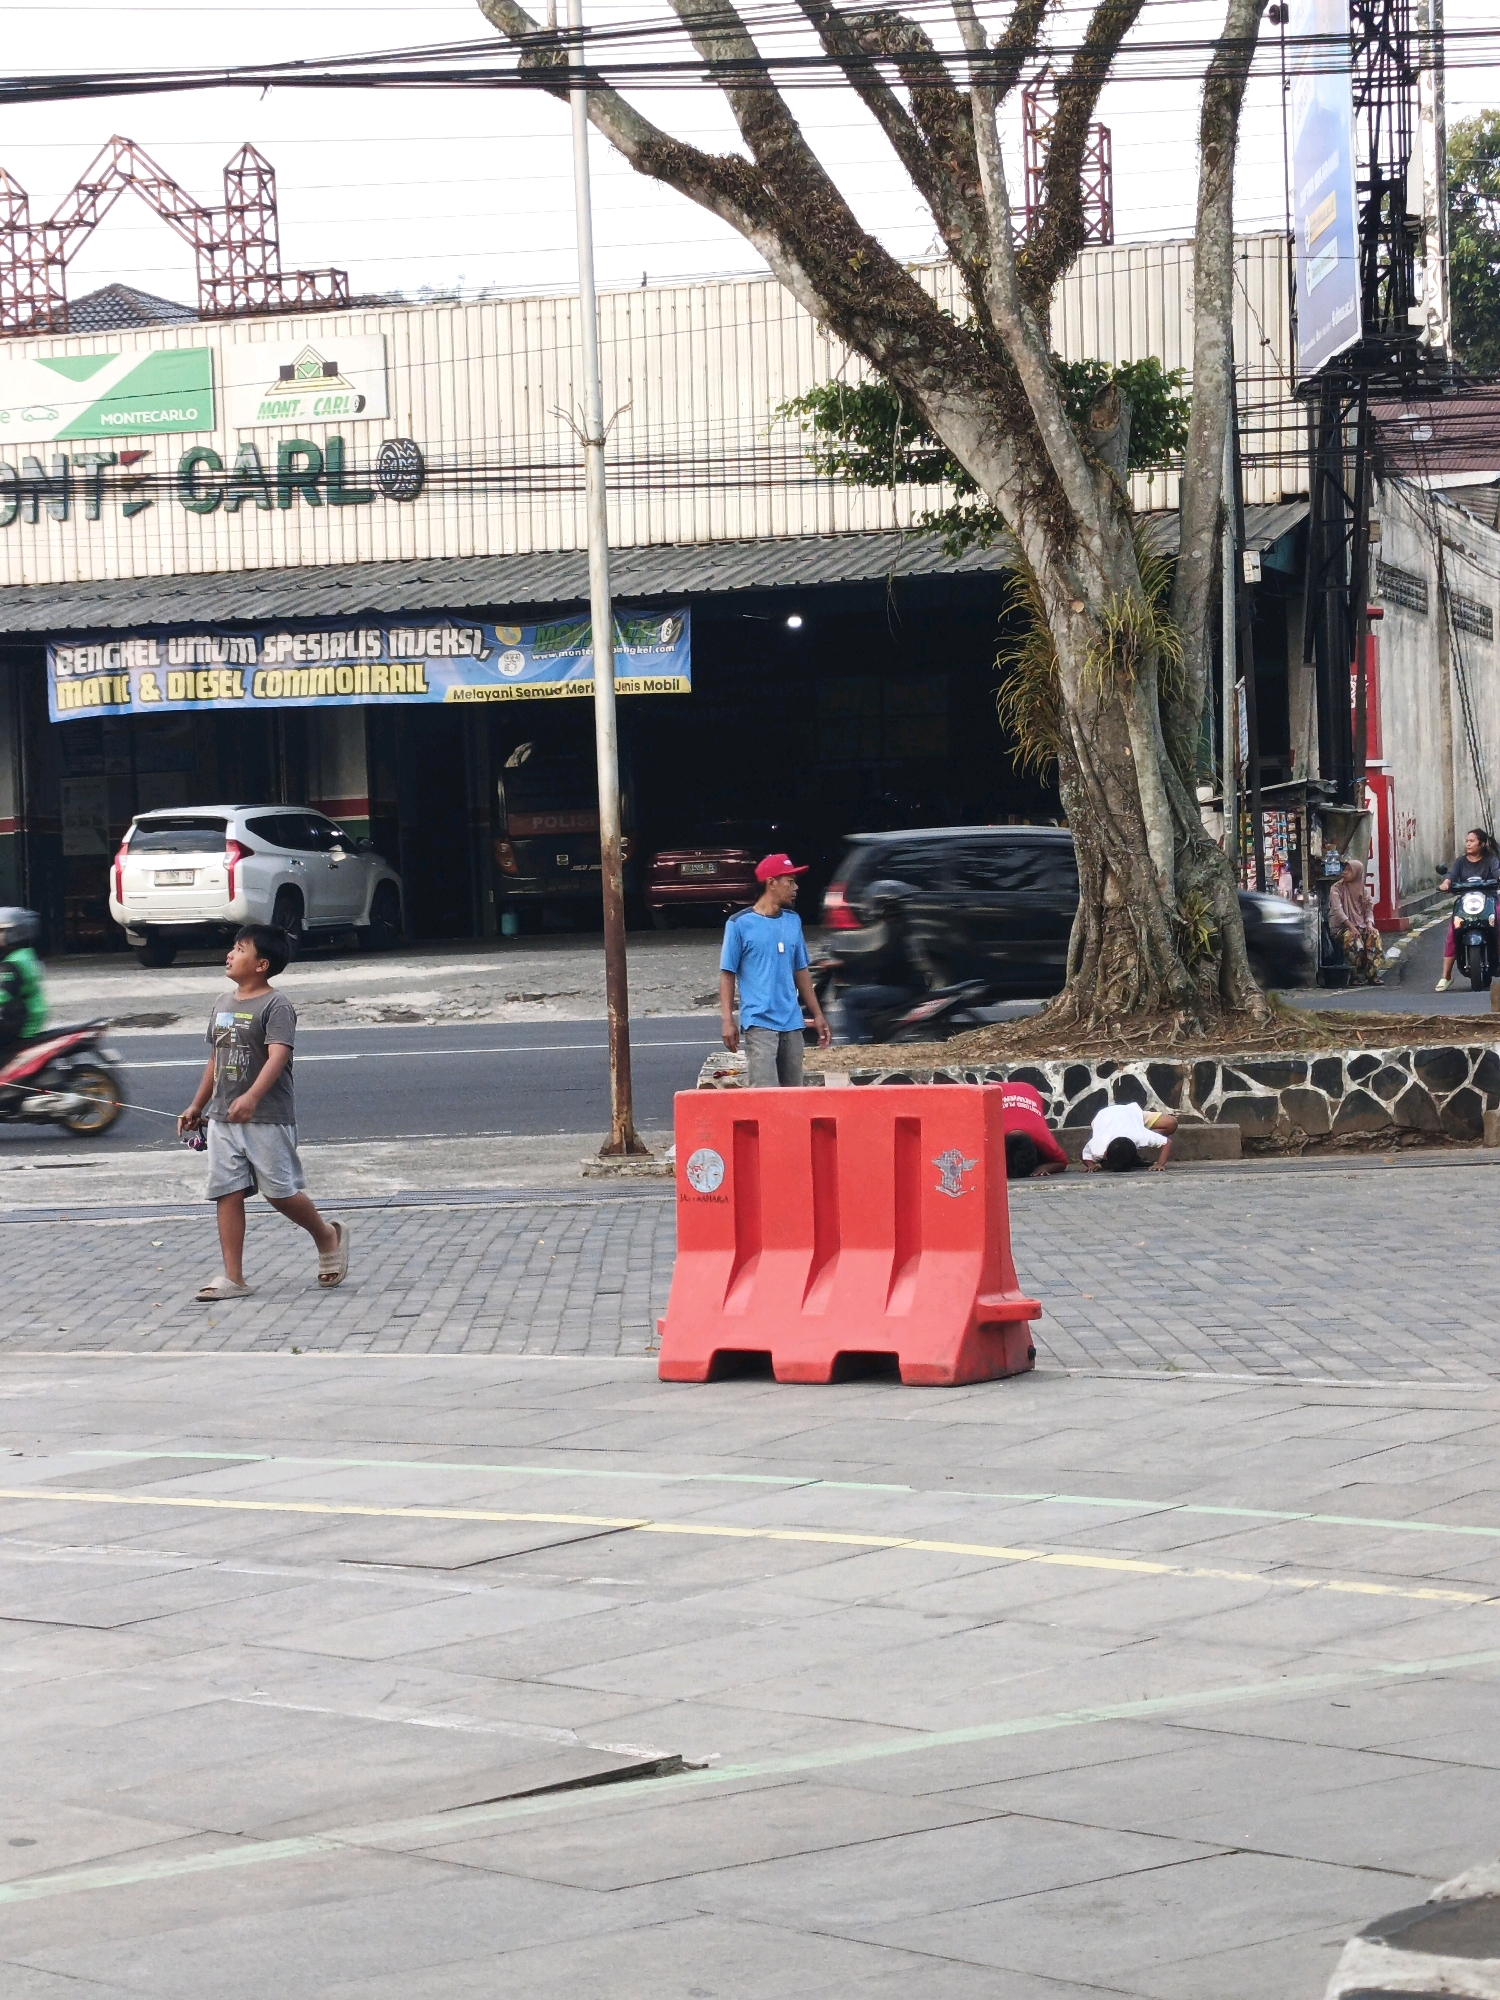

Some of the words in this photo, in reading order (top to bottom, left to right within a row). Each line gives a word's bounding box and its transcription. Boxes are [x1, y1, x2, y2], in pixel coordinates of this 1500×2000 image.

[100, 407, 198, 426] MONTECARLO
[56, 638, 161, 676] BENGKEL
[168, 635, 257, 665] UMUM
[263, 629, 381, 663] SPESIALIS
[56, 674, 131, 710] MATIC
[139, 671, 163, 701] &
[166, 668, 246, 700] DIESEL
[252, 664, 429, 698] COMMONRAIL
[453, 687, 514, 702] Melayani
[515, 685, 563, 699] Semua
[643, 678, 680, 691] Mobil
